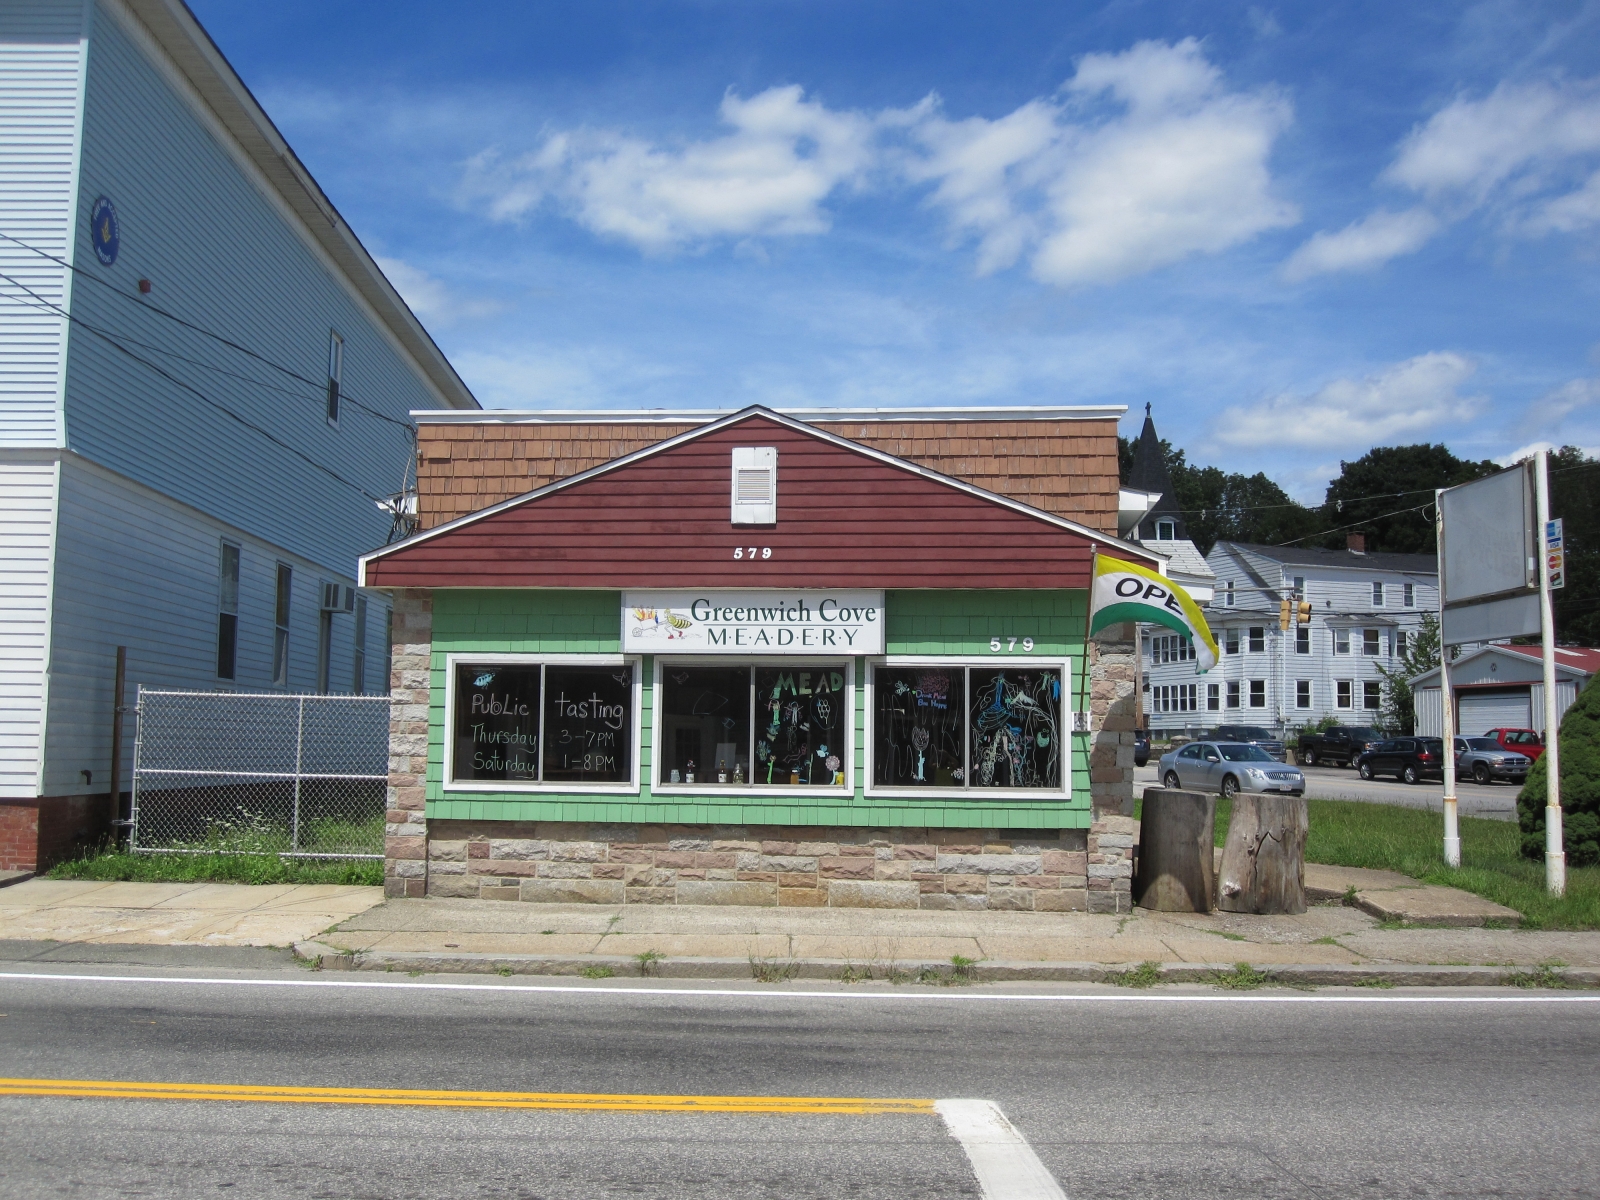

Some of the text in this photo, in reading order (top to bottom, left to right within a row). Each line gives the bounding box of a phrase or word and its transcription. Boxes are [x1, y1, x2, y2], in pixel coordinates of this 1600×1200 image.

[733, 547, 772, 559] 579
[691, 598, 877, 622] Greenwich Cove
[1115, 577, 1184, 616] OPE
[990, 637, 1034, 652] 579
[769, 671, 844, 699] MEAD
[554, 691, 625, 730] tasting
[470, 722, 537, 754] Thursday
[469, 750, 536, 779] Saturday
